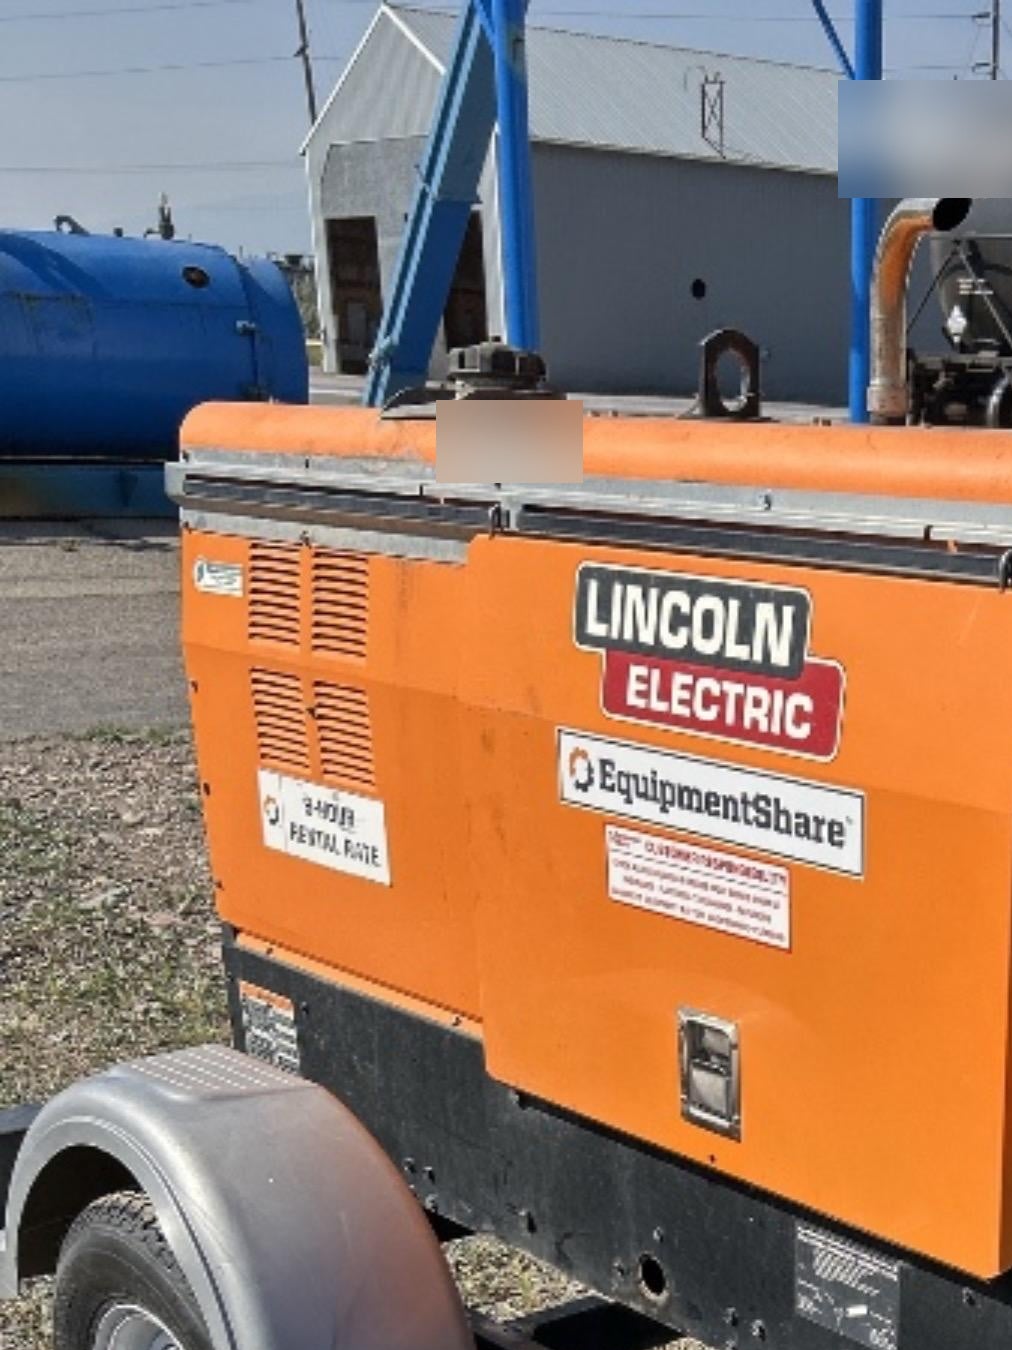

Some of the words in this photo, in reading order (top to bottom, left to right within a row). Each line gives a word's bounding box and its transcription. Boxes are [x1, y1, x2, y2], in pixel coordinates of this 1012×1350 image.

[585, 578, 796, 668] LINCOLN
[625, 663, 814, 739] ELECTRIC
[599, 757, 846, 849] EquipmentShare
